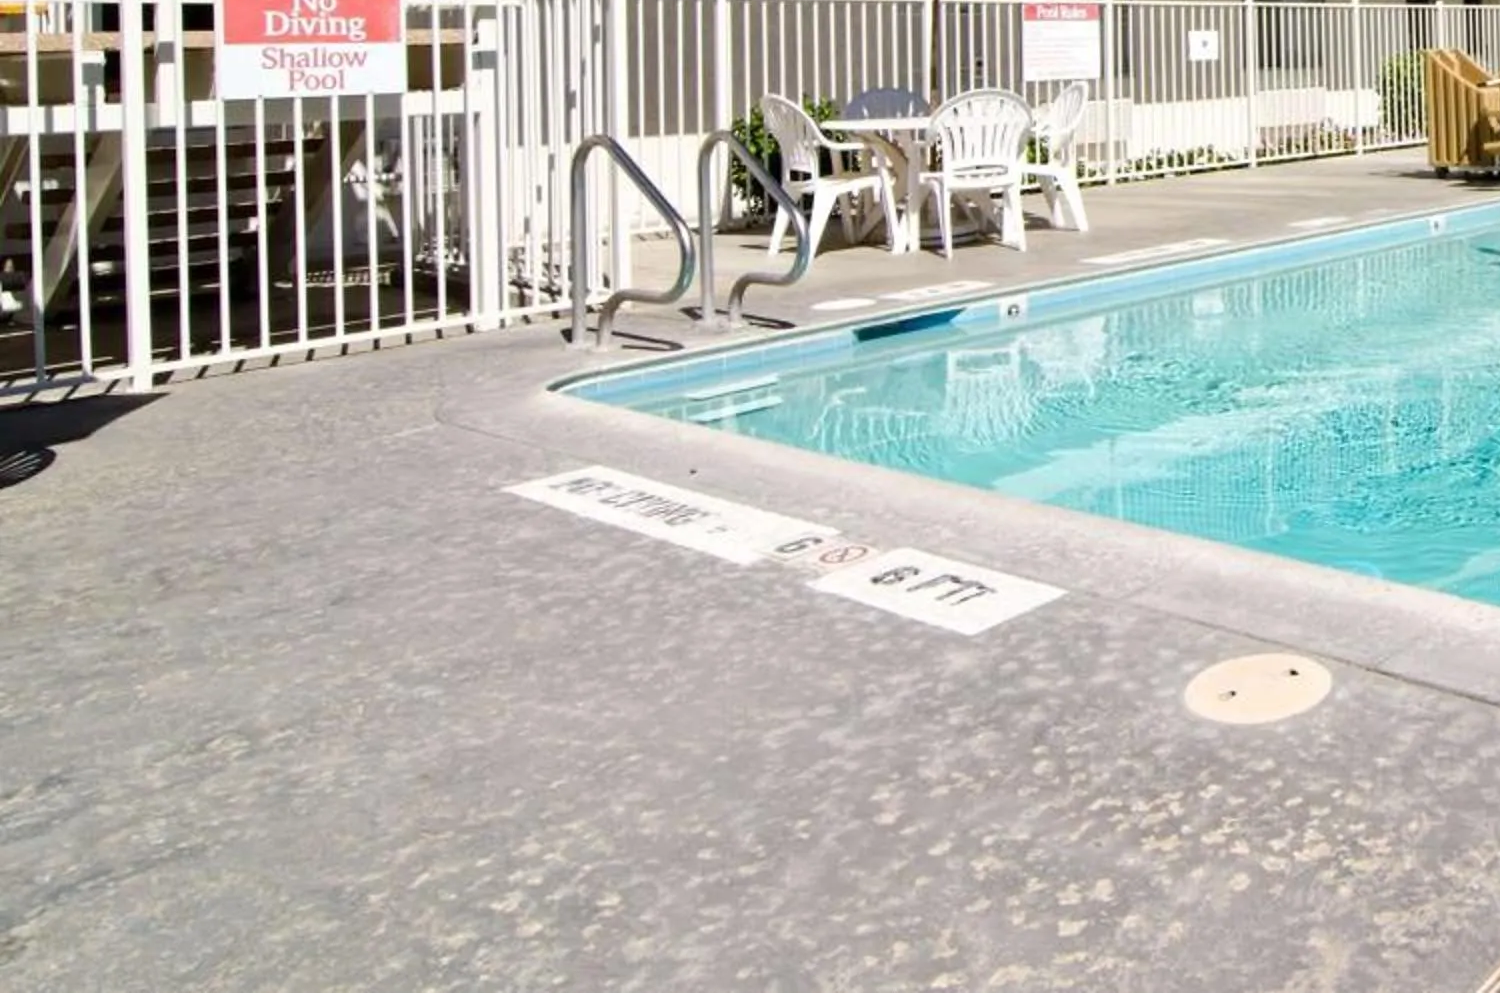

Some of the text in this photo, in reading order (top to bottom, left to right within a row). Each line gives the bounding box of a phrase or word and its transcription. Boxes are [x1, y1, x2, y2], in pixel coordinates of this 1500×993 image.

[264, 10, 367, 41] Diving
[261, 47, 367, 70] Shallow
[289, 69, 345, 91] Pool
[869, 565, 999, 607] 6 FT
